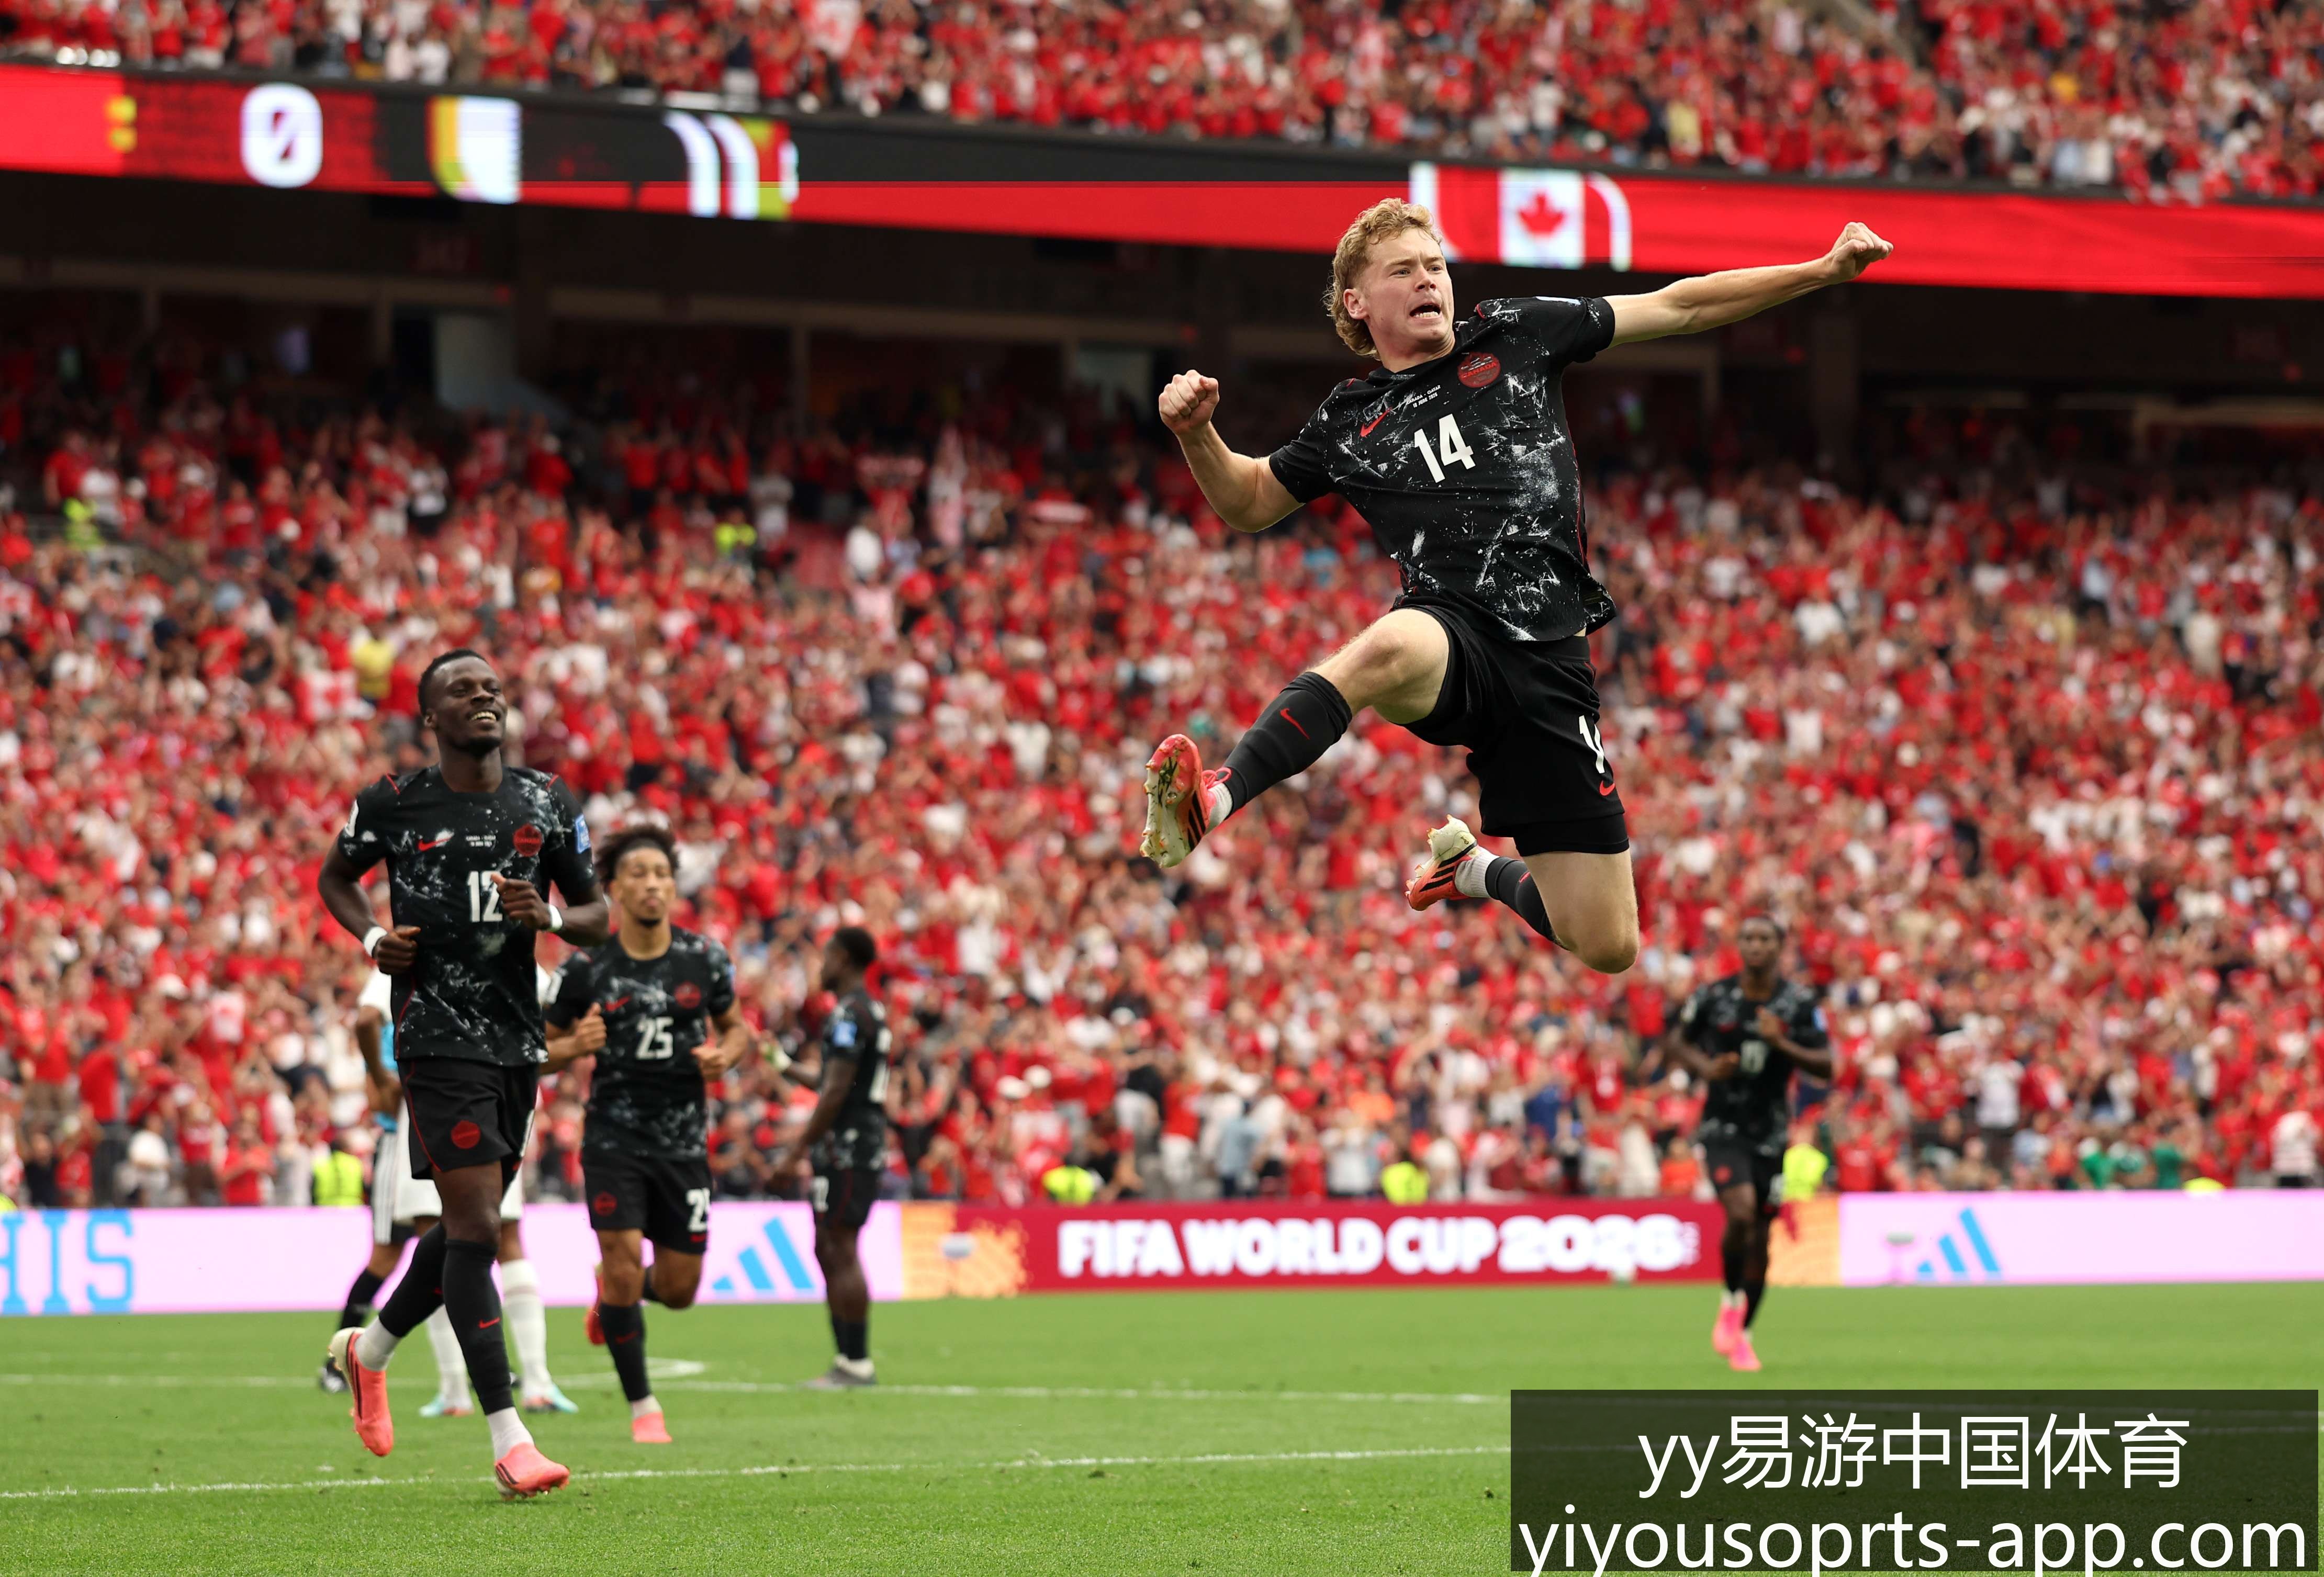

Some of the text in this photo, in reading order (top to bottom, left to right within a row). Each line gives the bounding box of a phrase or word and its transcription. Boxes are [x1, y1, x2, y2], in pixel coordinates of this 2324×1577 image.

[241, 84, 323, 187] 0
[1427, 385, 1441, 394] QATAR
[1462, 362, 1497, 378] CANADA
[1418, 397, 1428, 405] JUNE
[1414, 413, 1476, 483] 14
[467, 870, 503, 922] 12
[635, 1017, 674, 1060] 25
[1058, 1219, 1185, 1278] FIFA
[1180, 1216, 1384, 1277] WORLD
[1385, 1215, 1498, 1275] CUP
[1497, 1213, 1683, 1274] 2026
